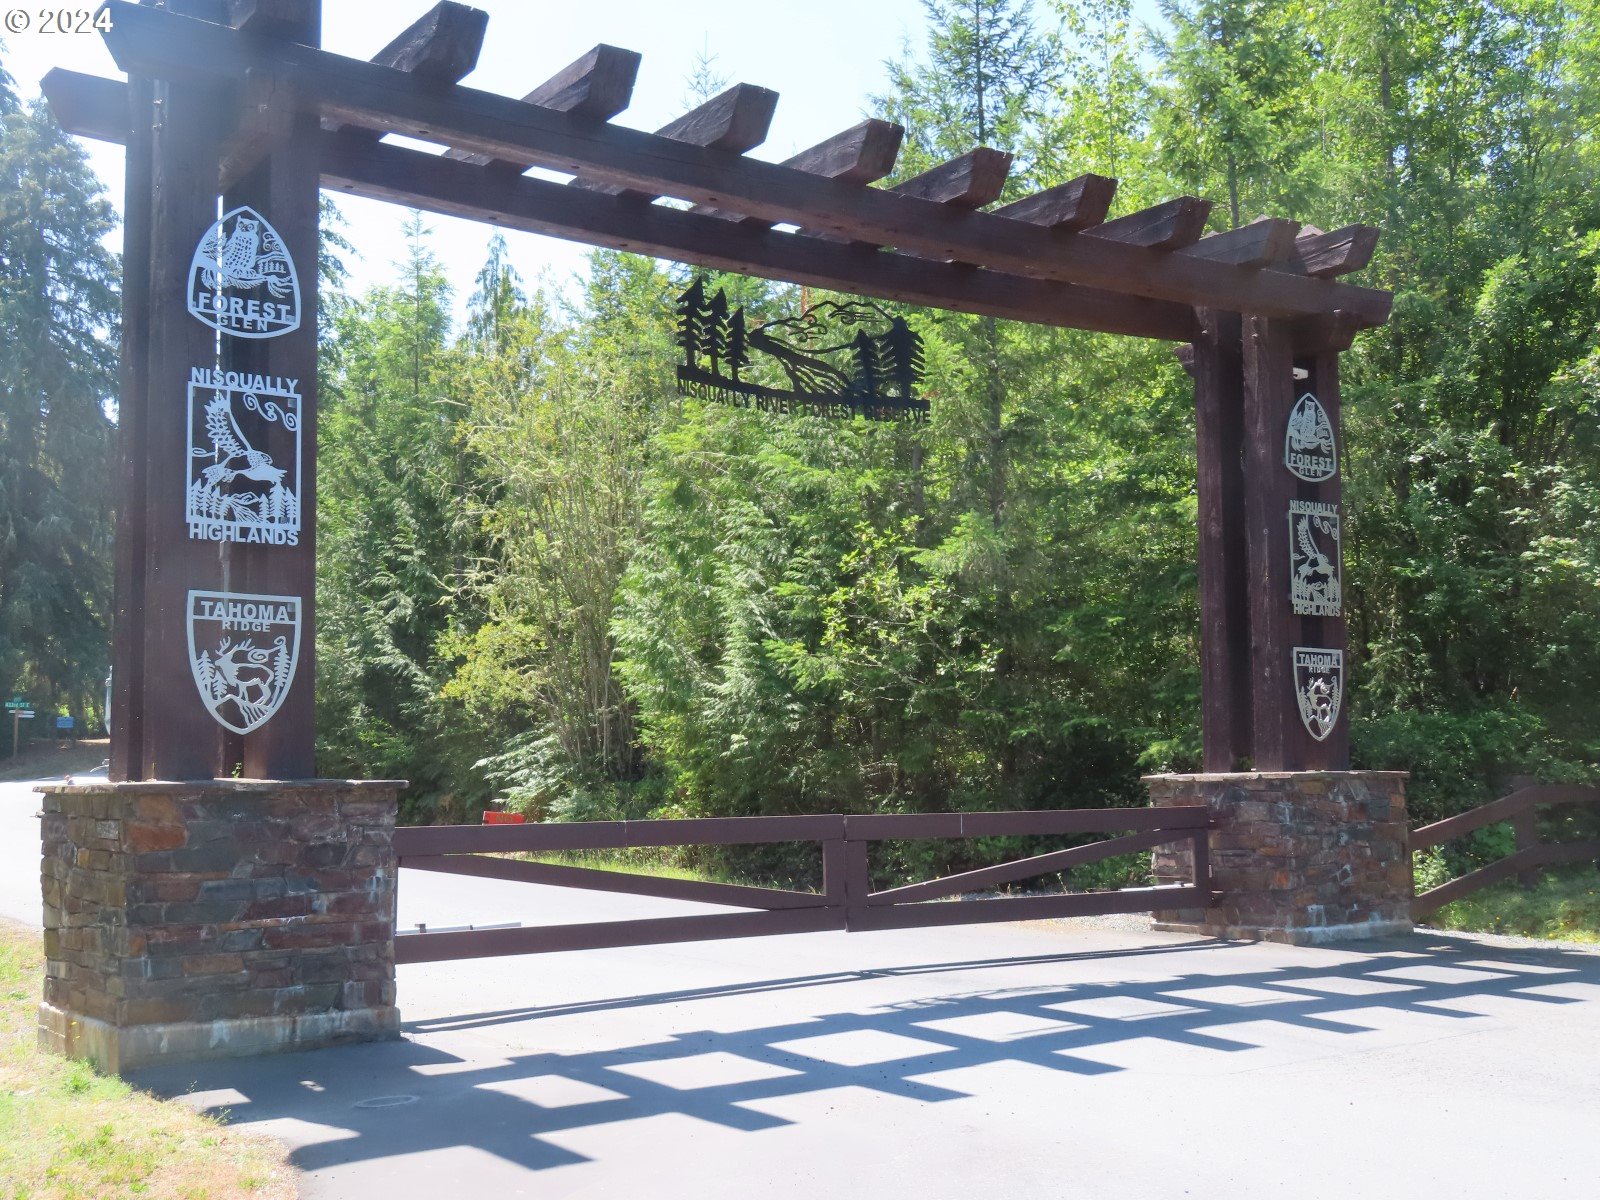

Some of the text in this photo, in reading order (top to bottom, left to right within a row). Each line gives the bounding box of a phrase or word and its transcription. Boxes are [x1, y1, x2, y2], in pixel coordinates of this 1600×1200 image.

[198, 291, 291, 322] FOREST
[219, 314, 268, 332] GLEN
[191, 366, 299, 394] NISQUALLY
[677, 378, 750, 409] NISQUALLY
[1290, 452, 1332, 470] FOREST
[1298, 466, 1323, 477] GLEN
[1289, 499, 1338, 515] NISQUALLY
[189, 521, 300, 546] HIGHLANDS
[200, 600, 290, 623] TAHOMA
[1293, 602, 1341, 618] HIGHLANDS
[221, 620, 271, 633] RIDGE
[1298, 653, 1338, 667] TAHOMA
